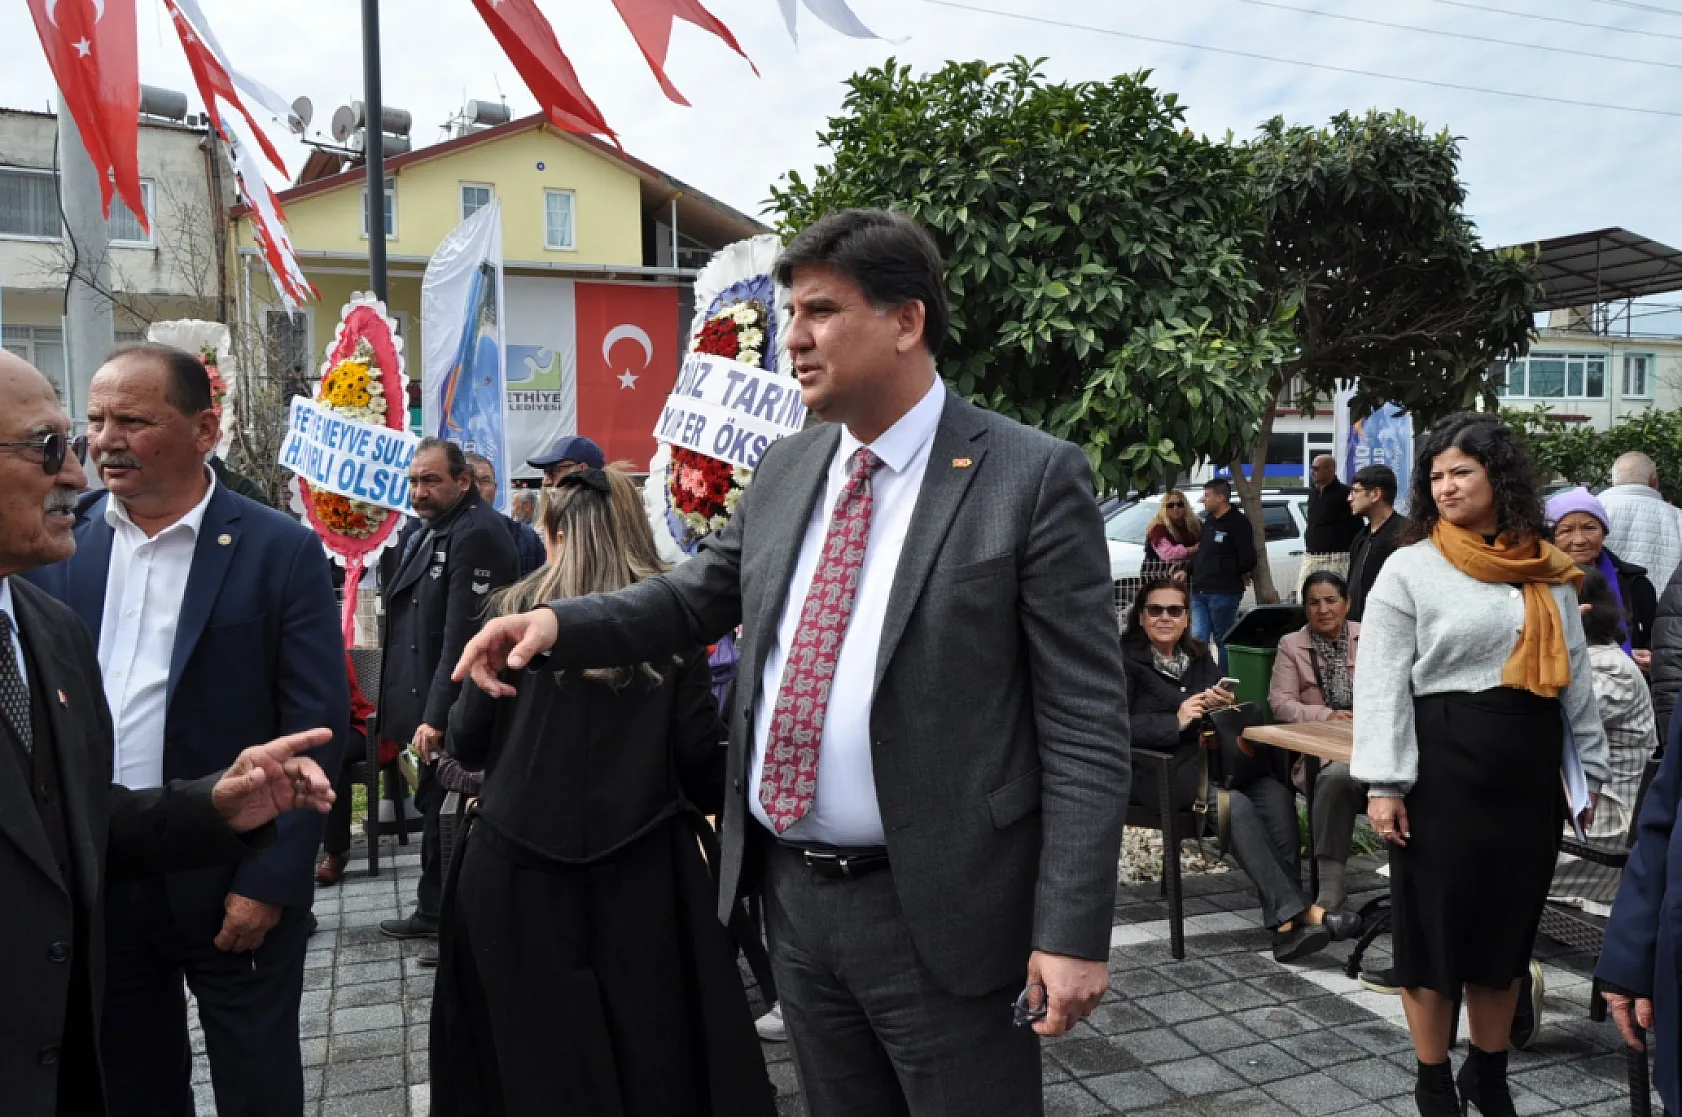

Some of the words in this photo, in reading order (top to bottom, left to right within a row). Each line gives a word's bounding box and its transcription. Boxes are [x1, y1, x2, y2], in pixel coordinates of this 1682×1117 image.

[507, 389, 561, 403] ETHİYE
[509, 402, 562, 411] LEDİYESİ
[713, 416, 784, 468] ÖKS
